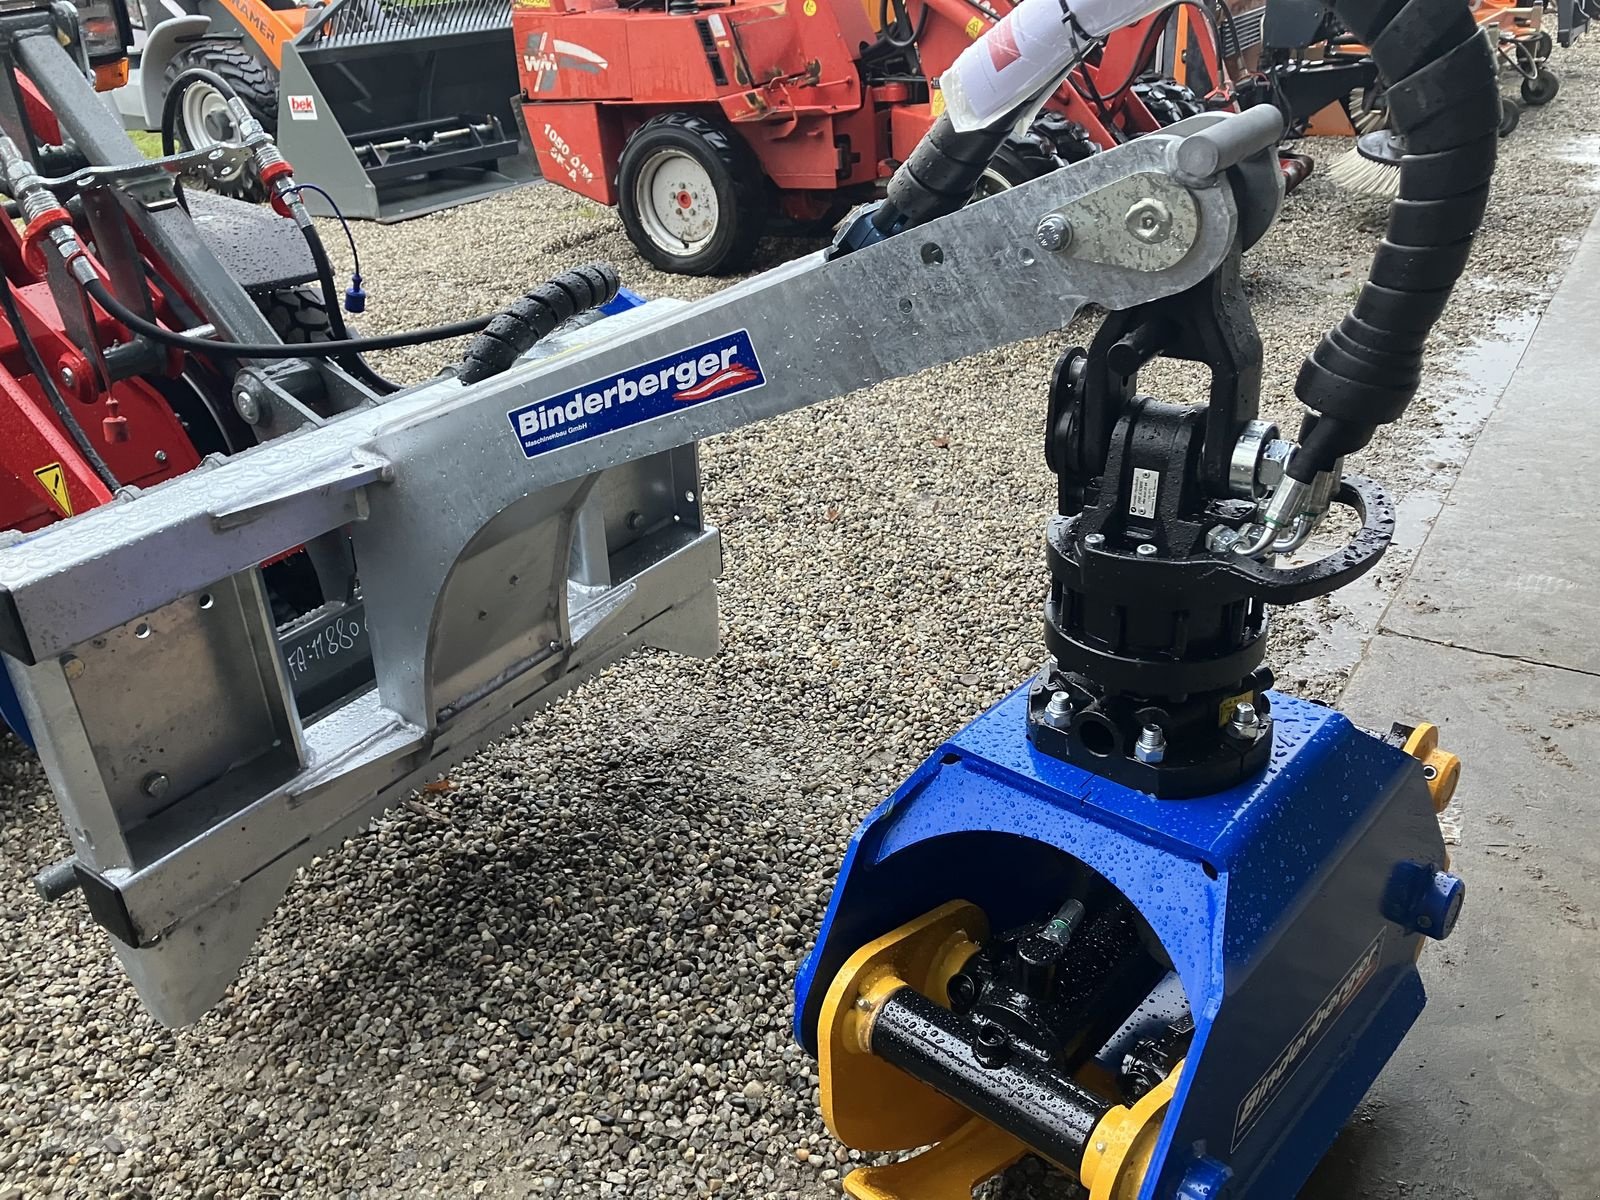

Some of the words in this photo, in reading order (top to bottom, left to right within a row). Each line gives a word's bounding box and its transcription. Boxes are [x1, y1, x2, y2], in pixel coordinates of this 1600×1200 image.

[291, 97, 313, 110] bek
[544, 123, 570, 155] 1050
[518, 345, 737, 437] Binderberger
[525, 430, 567, 447] Maschinenbau
[568, 422, 588, 433] GmbH
[1239, 943, 1378, 1127] Binderberger
